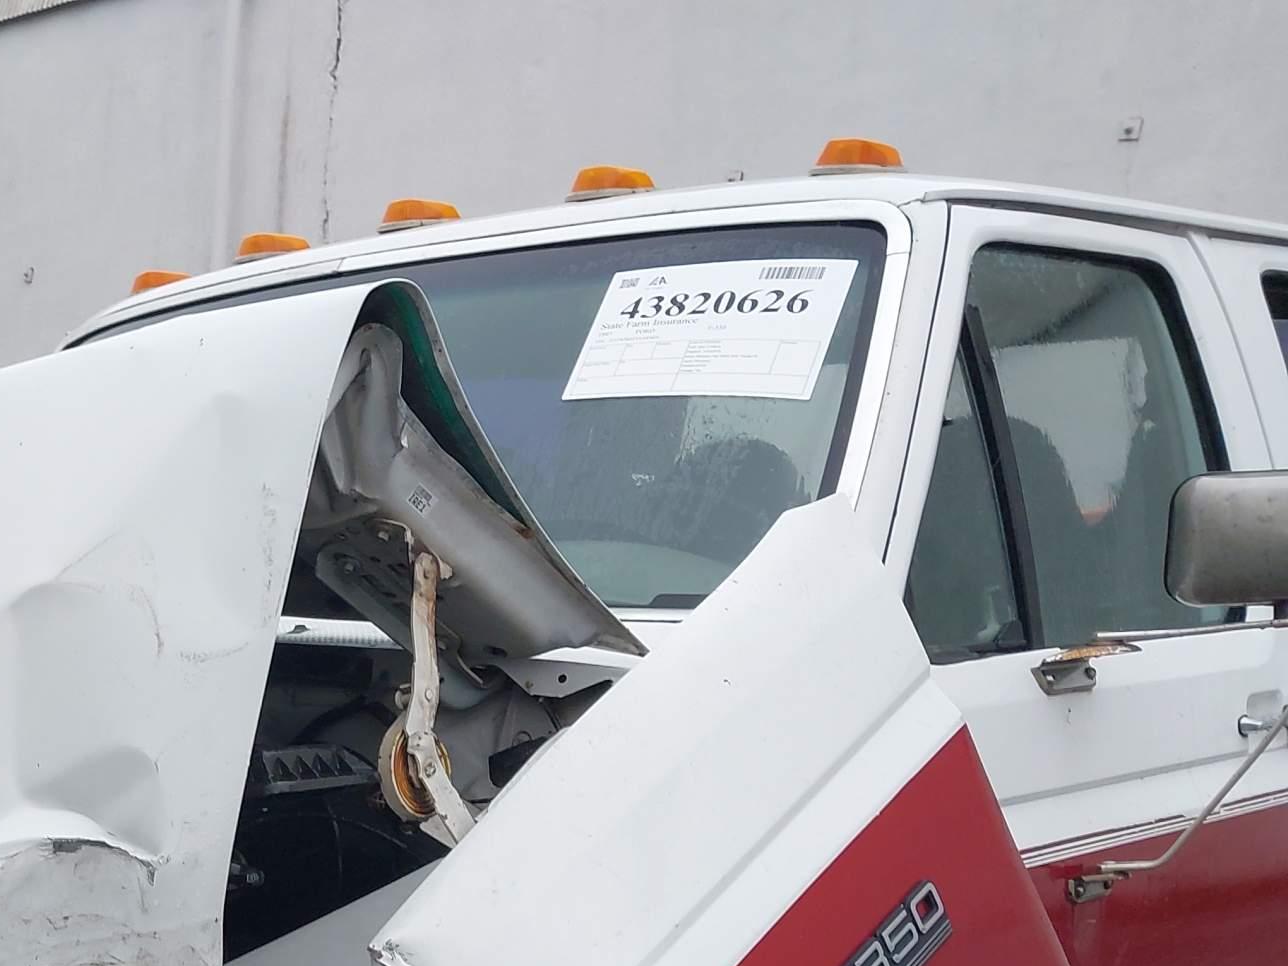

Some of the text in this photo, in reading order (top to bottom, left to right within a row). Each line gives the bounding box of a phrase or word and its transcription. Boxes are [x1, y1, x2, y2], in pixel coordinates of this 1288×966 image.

[620, 289, 815, 319] 43820626
[626, 320, 650, 328] Farm
[653, 318, 699, 327] Insurance
